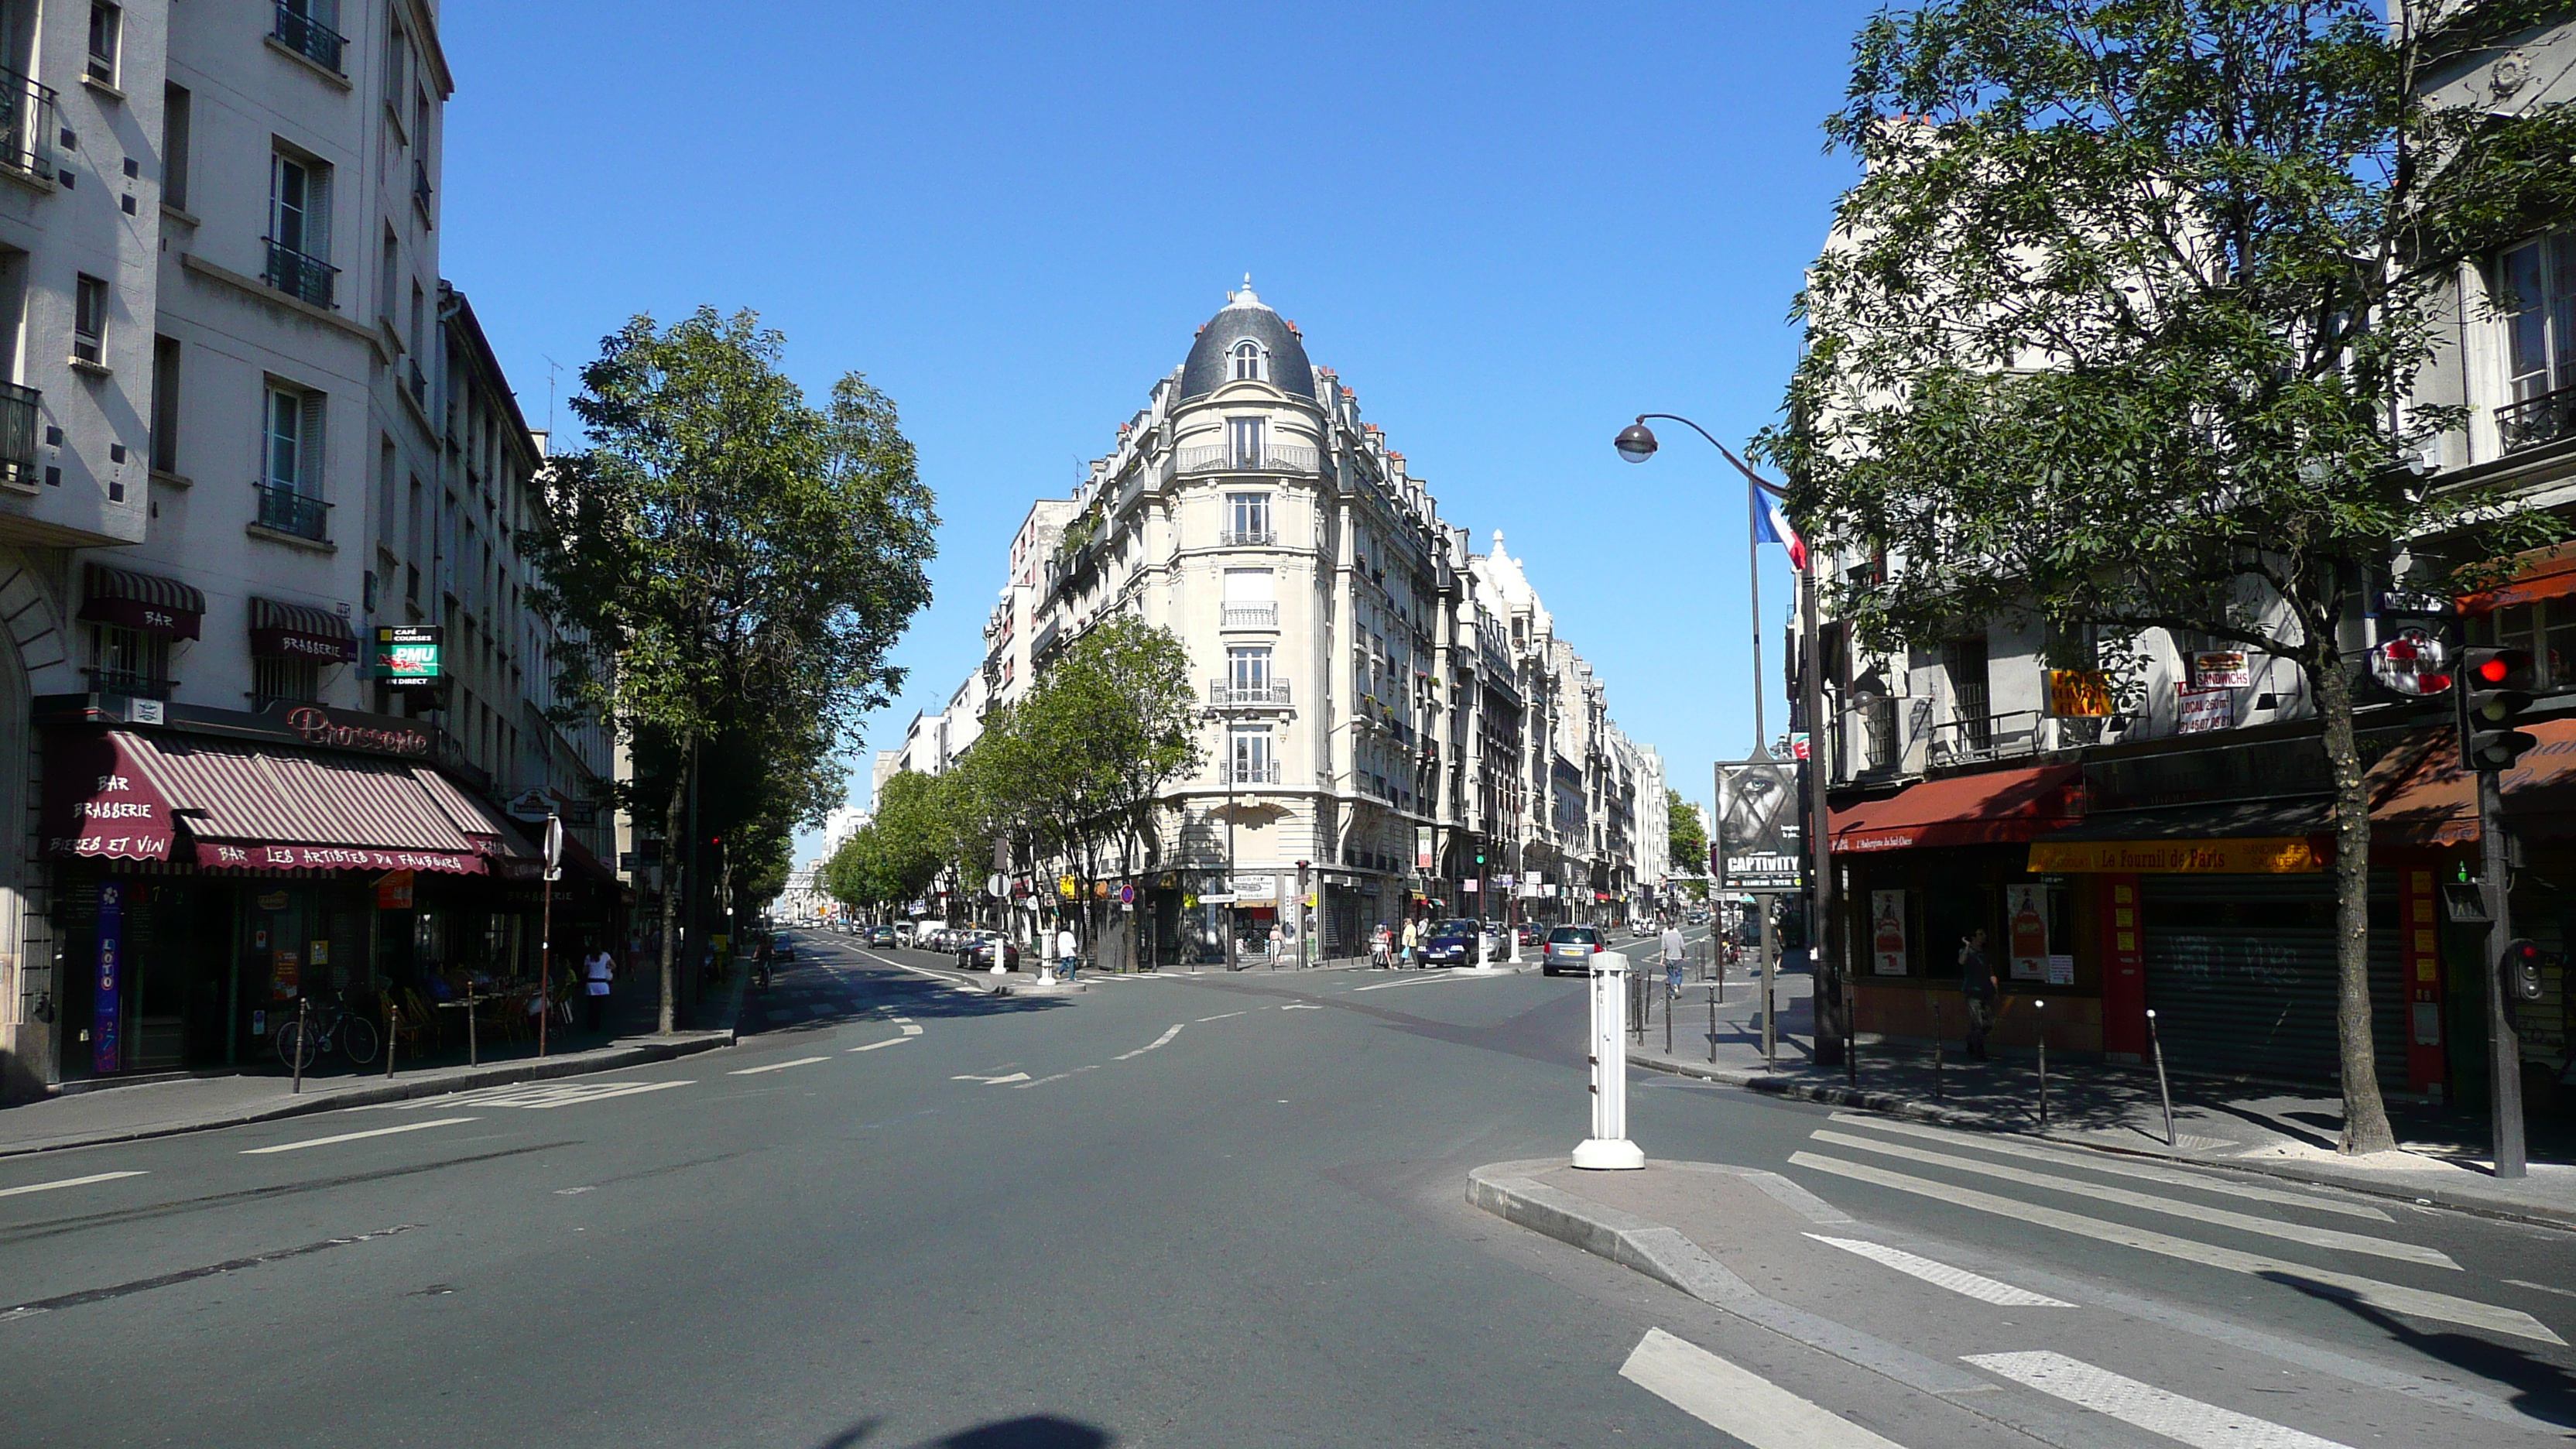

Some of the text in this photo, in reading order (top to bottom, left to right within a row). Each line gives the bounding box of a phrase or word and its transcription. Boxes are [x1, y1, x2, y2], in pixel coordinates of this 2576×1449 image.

[144, 611, 175, 629] BAR
[283, 637, 341, 658] BRASSERIE
[396, 647, 434, 662] PMU
[2197, 673, 2248, 685] SANDWICHS
[2181, 701, 2204, 714] LOCAL
[287, 706, 427, 755] Brasserie
[97, 774, 130, 792] BAR
[73, 801, 152, 819] BRASSERIE
[107, 837, 130, 852] ET
[2242, 844, 2310, 855] SANDWICHES
[218, 847, 248, 862] BAR
[266, 846, 294, 864] LES
[303, 848, 368, 865] ARTISTES
[398, 853, 463, 870] FAUBOURG
[1728, 856, 1799, 872] CAPTIVITY
[2102, 847, 2225, 868] Le Fournil de Paris
[2251, 857, 2300, 868] SALADES
[101, 938, 116, 991] LOTO
